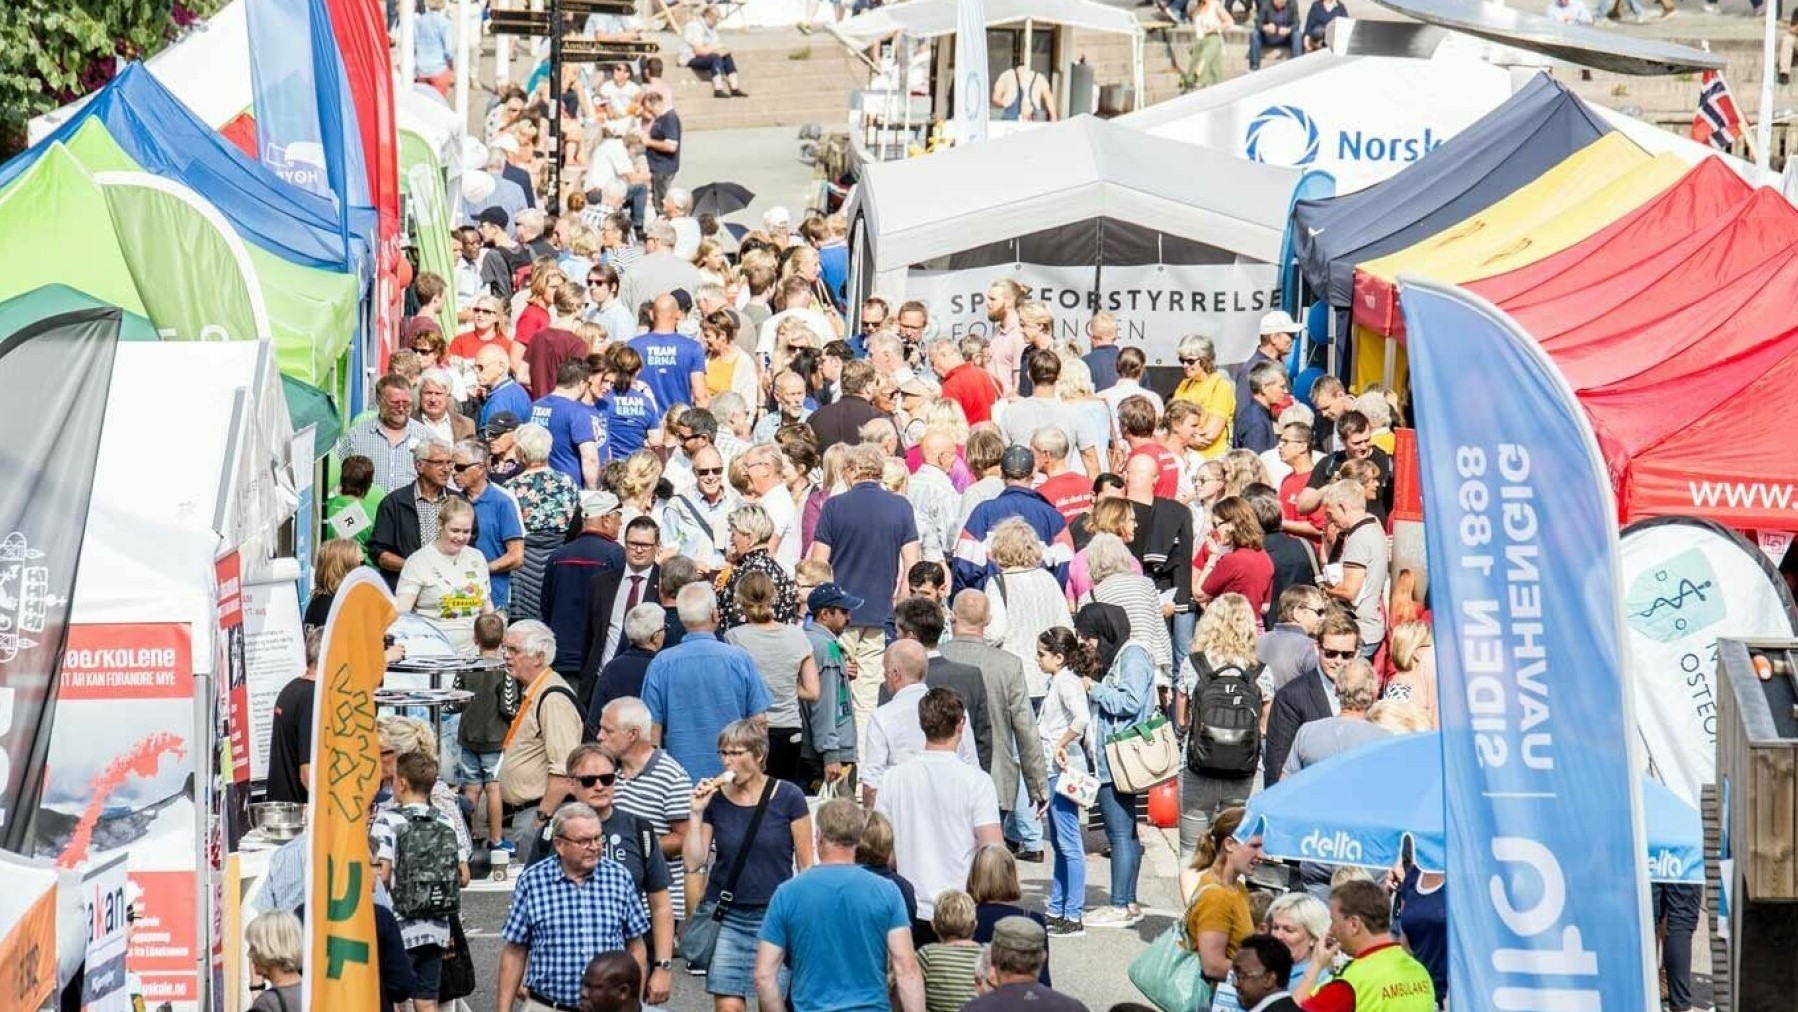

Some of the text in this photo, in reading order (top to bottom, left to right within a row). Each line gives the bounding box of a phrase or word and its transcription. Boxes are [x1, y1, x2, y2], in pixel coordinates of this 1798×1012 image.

[951, 289, 1282, 314] SPFORSTYRRELSE
[646, 346, 676, 356] TEAM
[647, 356, 676, 365] ERNA
[614, 396, 644, 406] TEAM
[532, 406, 552, 416] TEAM
[616, 405, 645, 416] ERNA
[344, 515, 355, 528] R
[85, 671, 106, 686] KAN
[106, 671, 155, 686] FORANDRE
[155, 671, 176, 685] MYE
[1680, 652, 1718, 744] OSTEO
[1300, 828, 1363, 861] delta
[87, 884, 124, 945] akan
